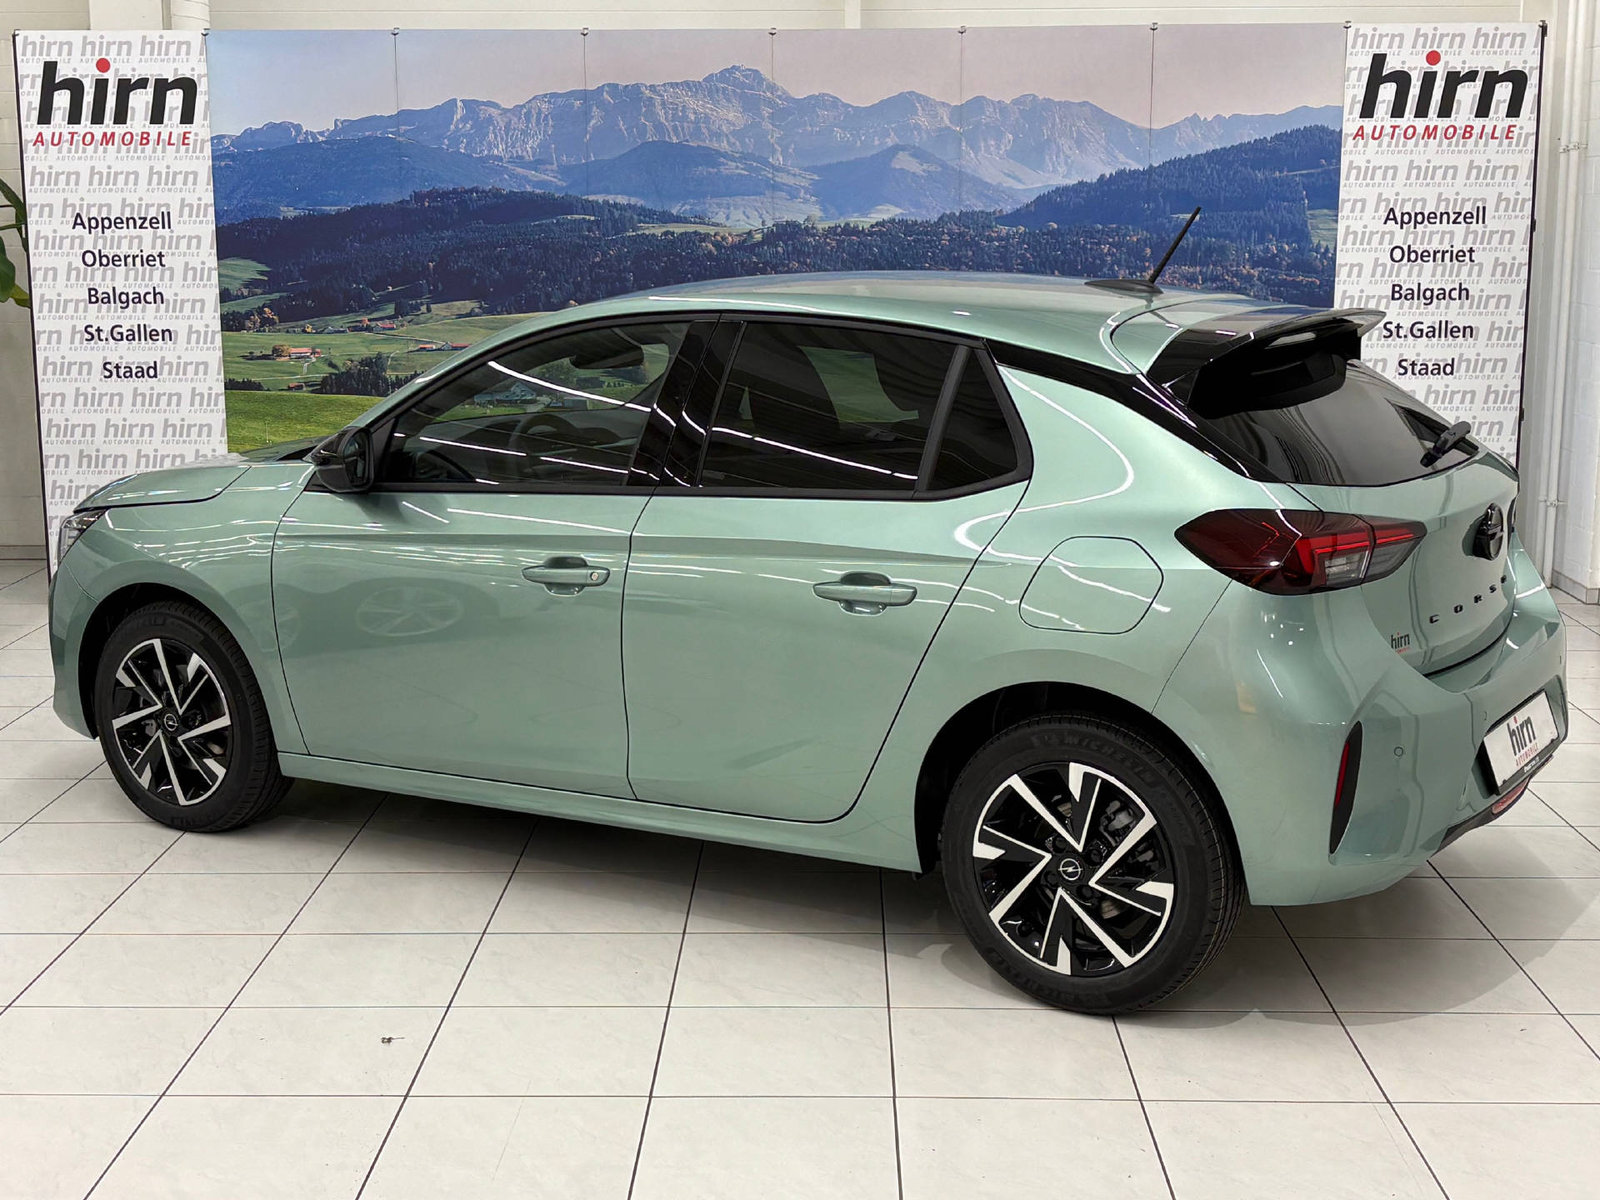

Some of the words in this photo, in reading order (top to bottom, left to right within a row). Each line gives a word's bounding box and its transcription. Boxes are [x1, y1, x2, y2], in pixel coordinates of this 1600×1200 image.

[21, 36, 72, 56] hirn
[80, 36, 132, 56] hirn
[140, 36, 191, 56] hirn
[1351, 28, 1404, 49] hirn
[1412, 28, 1465, 48] hirn
[1473, 27, 1526, 48] hirn
[37, 58, 198, 125] hirn
[1359, 50, 1528, 118] hirn
[32, 131, 192, 146] AUTOMOBILE
[1352, 124, 1517, 140] AUTOMOBILE
[29, 166, 80, 186] hirn
[88, 166, 139, 186] hirn
[147, 166, 198, 186] hirn
[1345, 160, 1397, 180] hirn
[1406, 160, 1458, 180] hirn
[1466, 160, 1518, 180] hirn
[29, 203, 53, 218] rn
[61, 198, 112, 218] hirn
[120, 198, 170, 218] hirn
[178, 198, 213, 218] hir
[1339, 198, 1366, 213] rn
[1374, 193, 1426, 213] hirn
[1434, 192, 1486, 213] hirn
[1494, 192, 1530, 213] hir
[72, 212, 172, 234] Appenzell
[1383, 206, 1486, 230] Appenzell
[34, 230, 84, 250] hirn
[92, 230, 143, 250] hirn
[151, 230, 202, 249] hirn
[1342, 225, 1394, 245] hirn
[1402, 225, 1454, 245] hirn
[1463, 225, 1515, 245] hirn
[82, 250, 166, 268] Oberriet
[1390, 244, 1476, 263] Oberriet
[33, 267, 57, 281] rn
[182, 262, 217, 281] hir
[1335, 262, 1363, 277] rn
[1491, 257, 1527, 277] hir
[38, 293, 88, 313] hirn
[88, 286, 164, 309] Balgach
[1391, 282, 1470, 305] Balgach
[37, 330, 61, 344] rn
[185, 325, 221, 344] hir
[84, 324, 172, 342] St.Gallen
[1382, 320, 1474, 339] St.Gallen
[1487, 322, 1522, 341] hir
[42, 356, 92, 375] hirn
[158, 356, 208, 375] hirn
[103, 361, 158, 379] Staad
[1398, 358, 1455, 376] Staad
[1456, 353, 1507, 373] hirn
[41, 392, 65, 406] rn
[73, 387, 123, 406] hirn
[131, 387, 181, 406] hirn
[189, 387, 224, 406] hir
[1424, 385, 1476, 404] hirn
[1484, 385, 1518, 404] hir
[46, 418, 96, 437] hirn
[104, 418, 154, 438] hirn
[162, 418, 212, 438] hirn
[45, 454, 69, 468] rn
[77, 449, 127, 468] hirn
[134, 449, 184, 468] hirn
[1391, 632, 1410, 649] hirn
[1507, 716, 1536, 756] hirn
